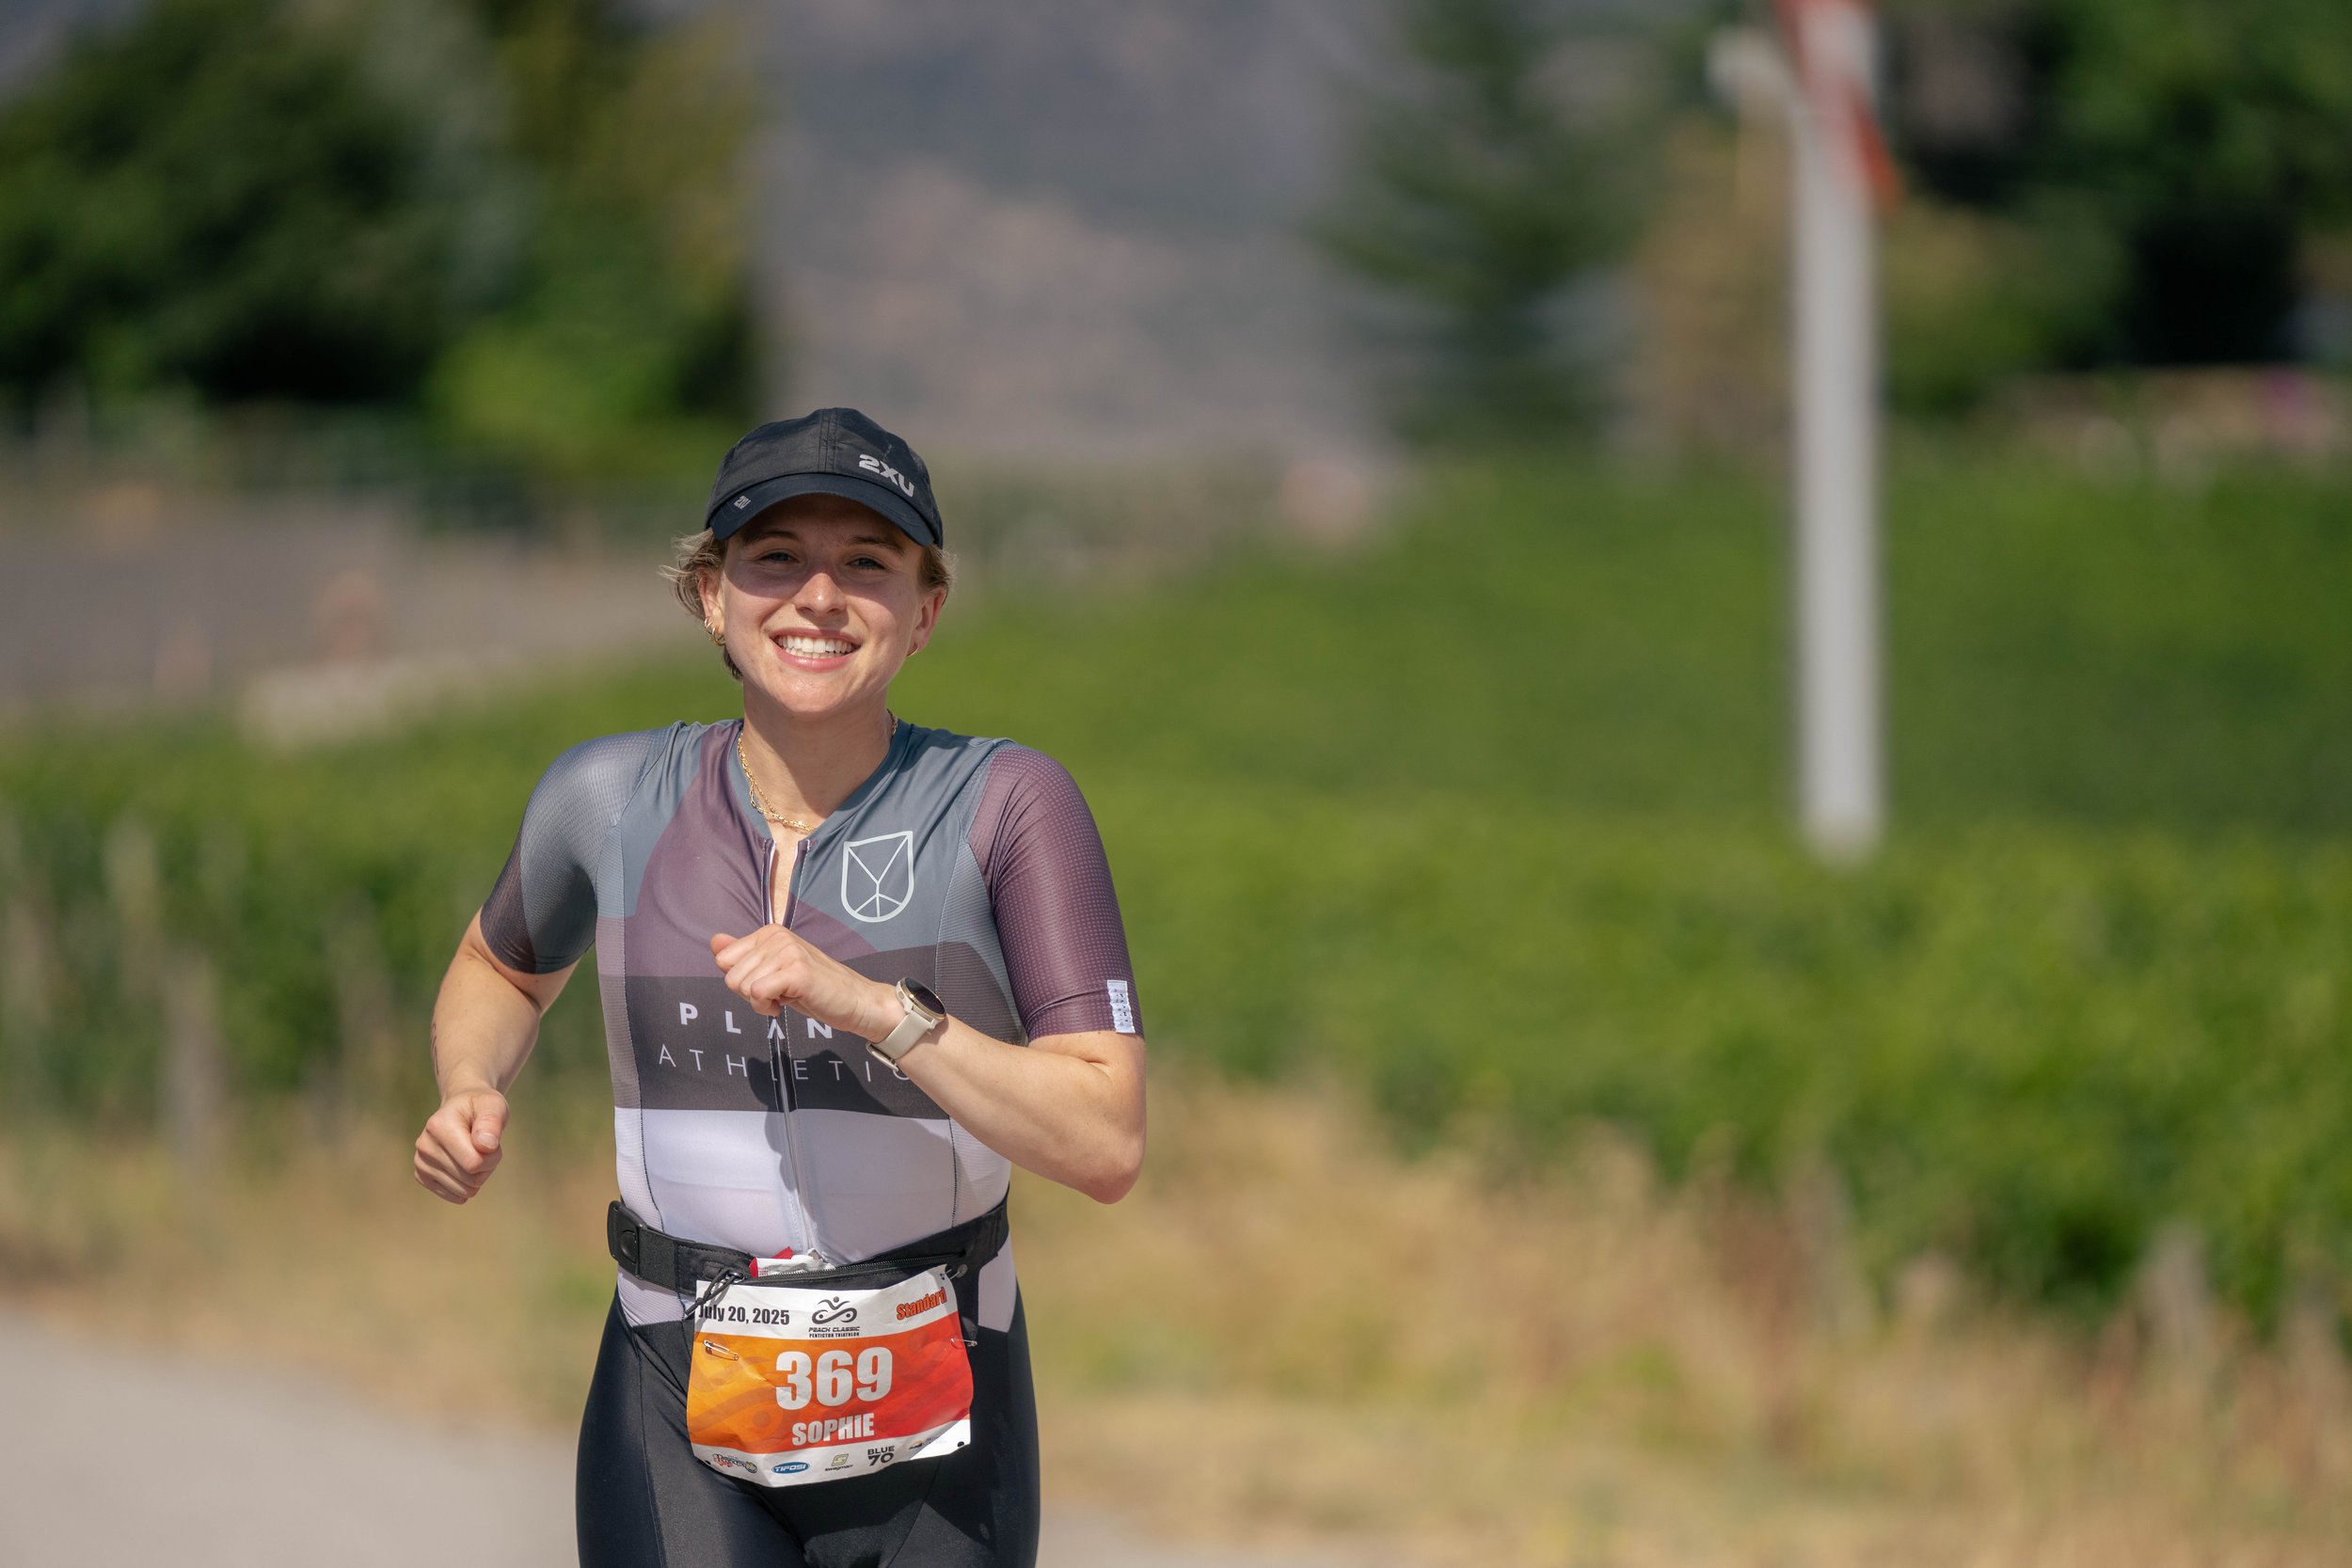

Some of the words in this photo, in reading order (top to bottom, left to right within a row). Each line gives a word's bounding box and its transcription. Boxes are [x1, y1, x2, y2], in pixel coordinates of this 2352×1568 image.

[859, 454, 914, 498] 2XU
[679, 1002, 833, 1039] PLAN
[698, 1304, 724, 1322] July
[727, 1306, 749, 1324] 20,
[752, 1307, 790, 1325] 2025
[897, 1286, 947, 1320] Standard
[775, 1346, 893, 1410] 369
[791, 1413, 875, 1446] SOPHIE
[867, 1446, 896, 1455] BLUE
[867, 1452, 895, 1466] 70
[774, 1464, 806, 1472] TIFOSI
